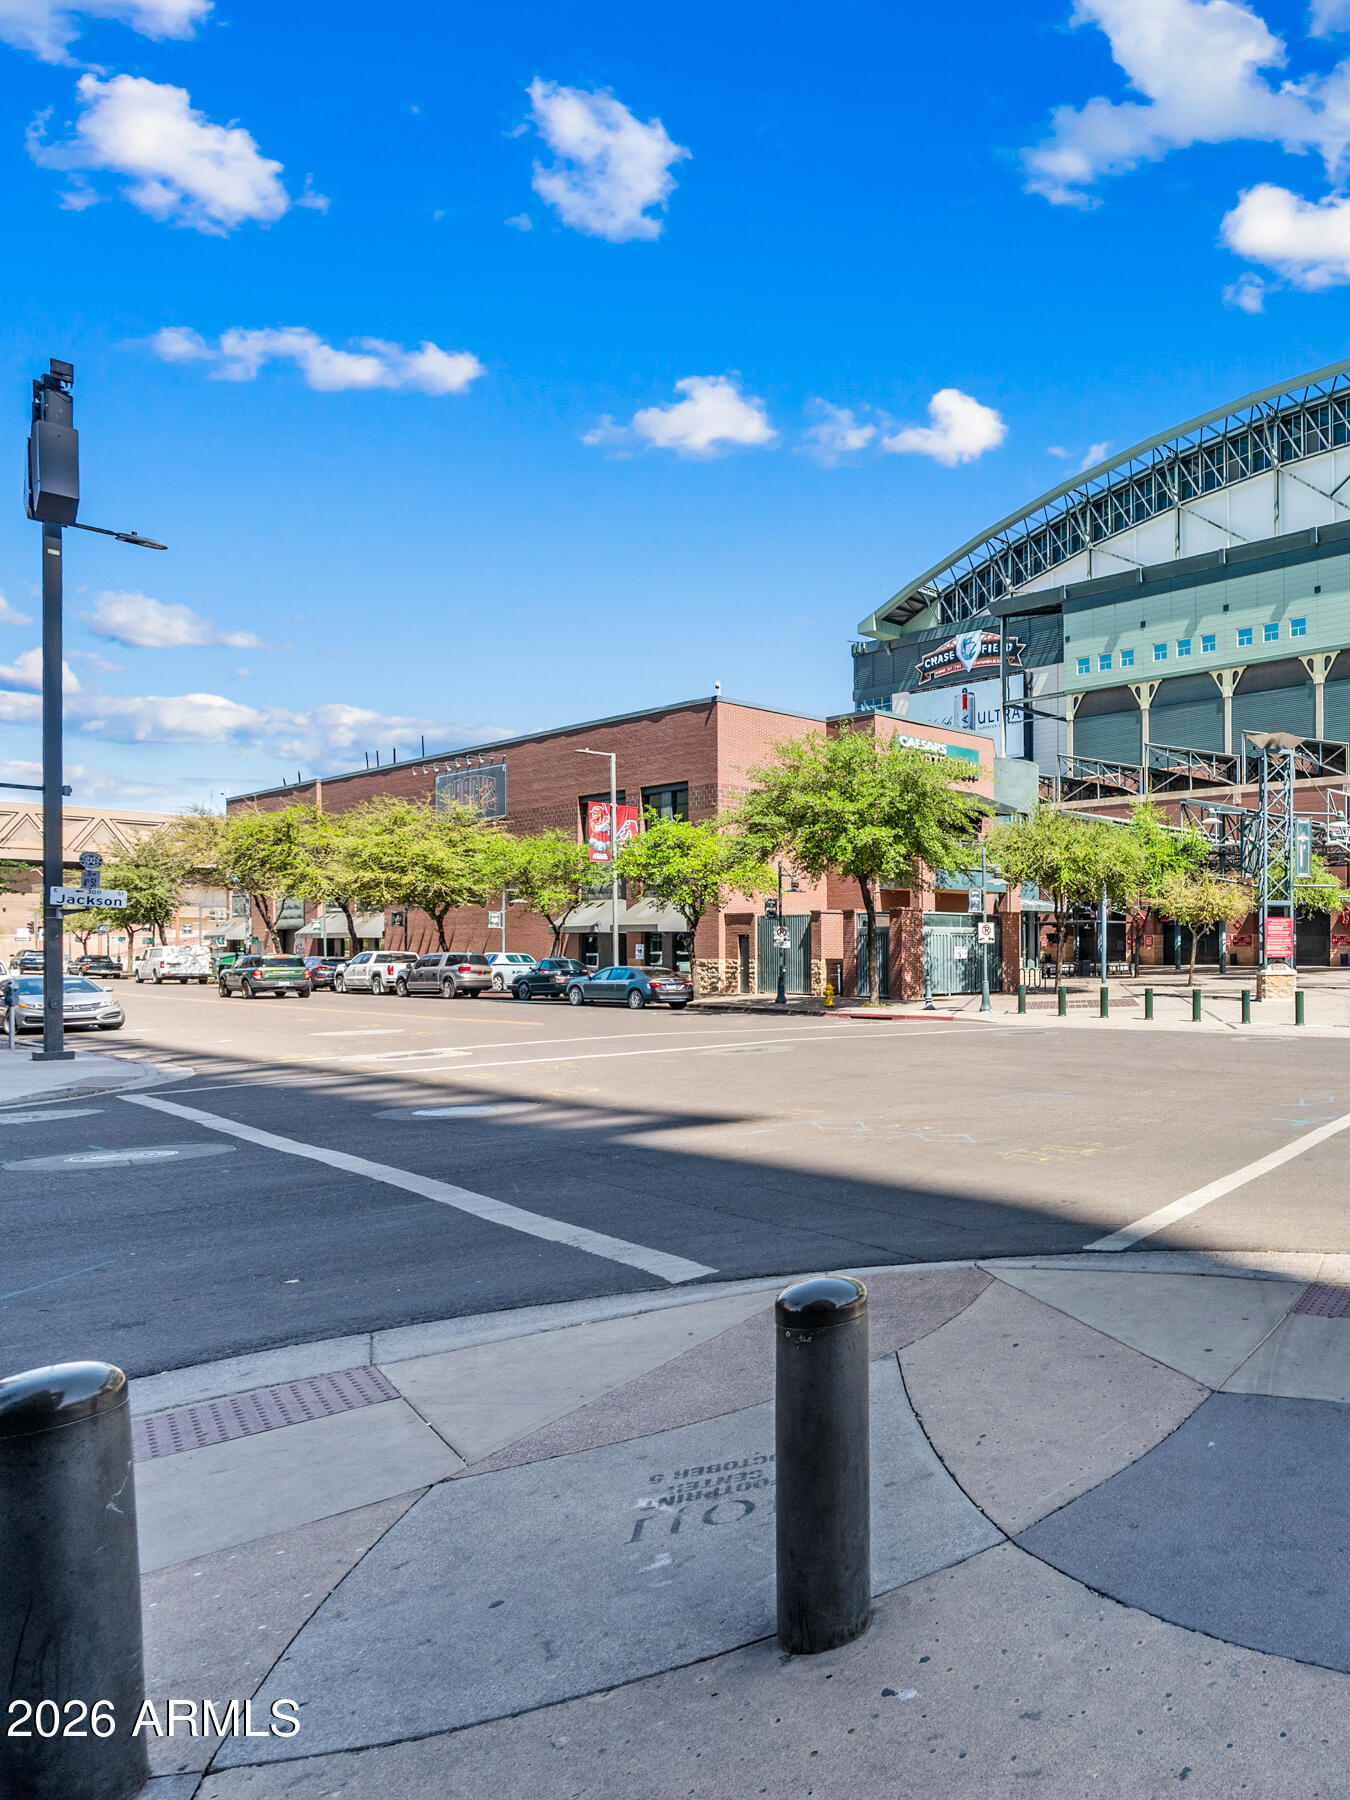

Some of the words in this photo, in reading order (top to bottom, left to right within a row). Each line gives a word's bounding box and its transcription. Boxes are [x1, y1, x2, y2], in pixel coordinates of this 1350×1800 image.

[924, 650, 955, 668] CHASE
[981, 642, 1013, 654] FIED
[898, 735, 947, 755] CAESARS
[56, 894, 122, 906] Jackson
[649, 1473, 665, 1485] 5
